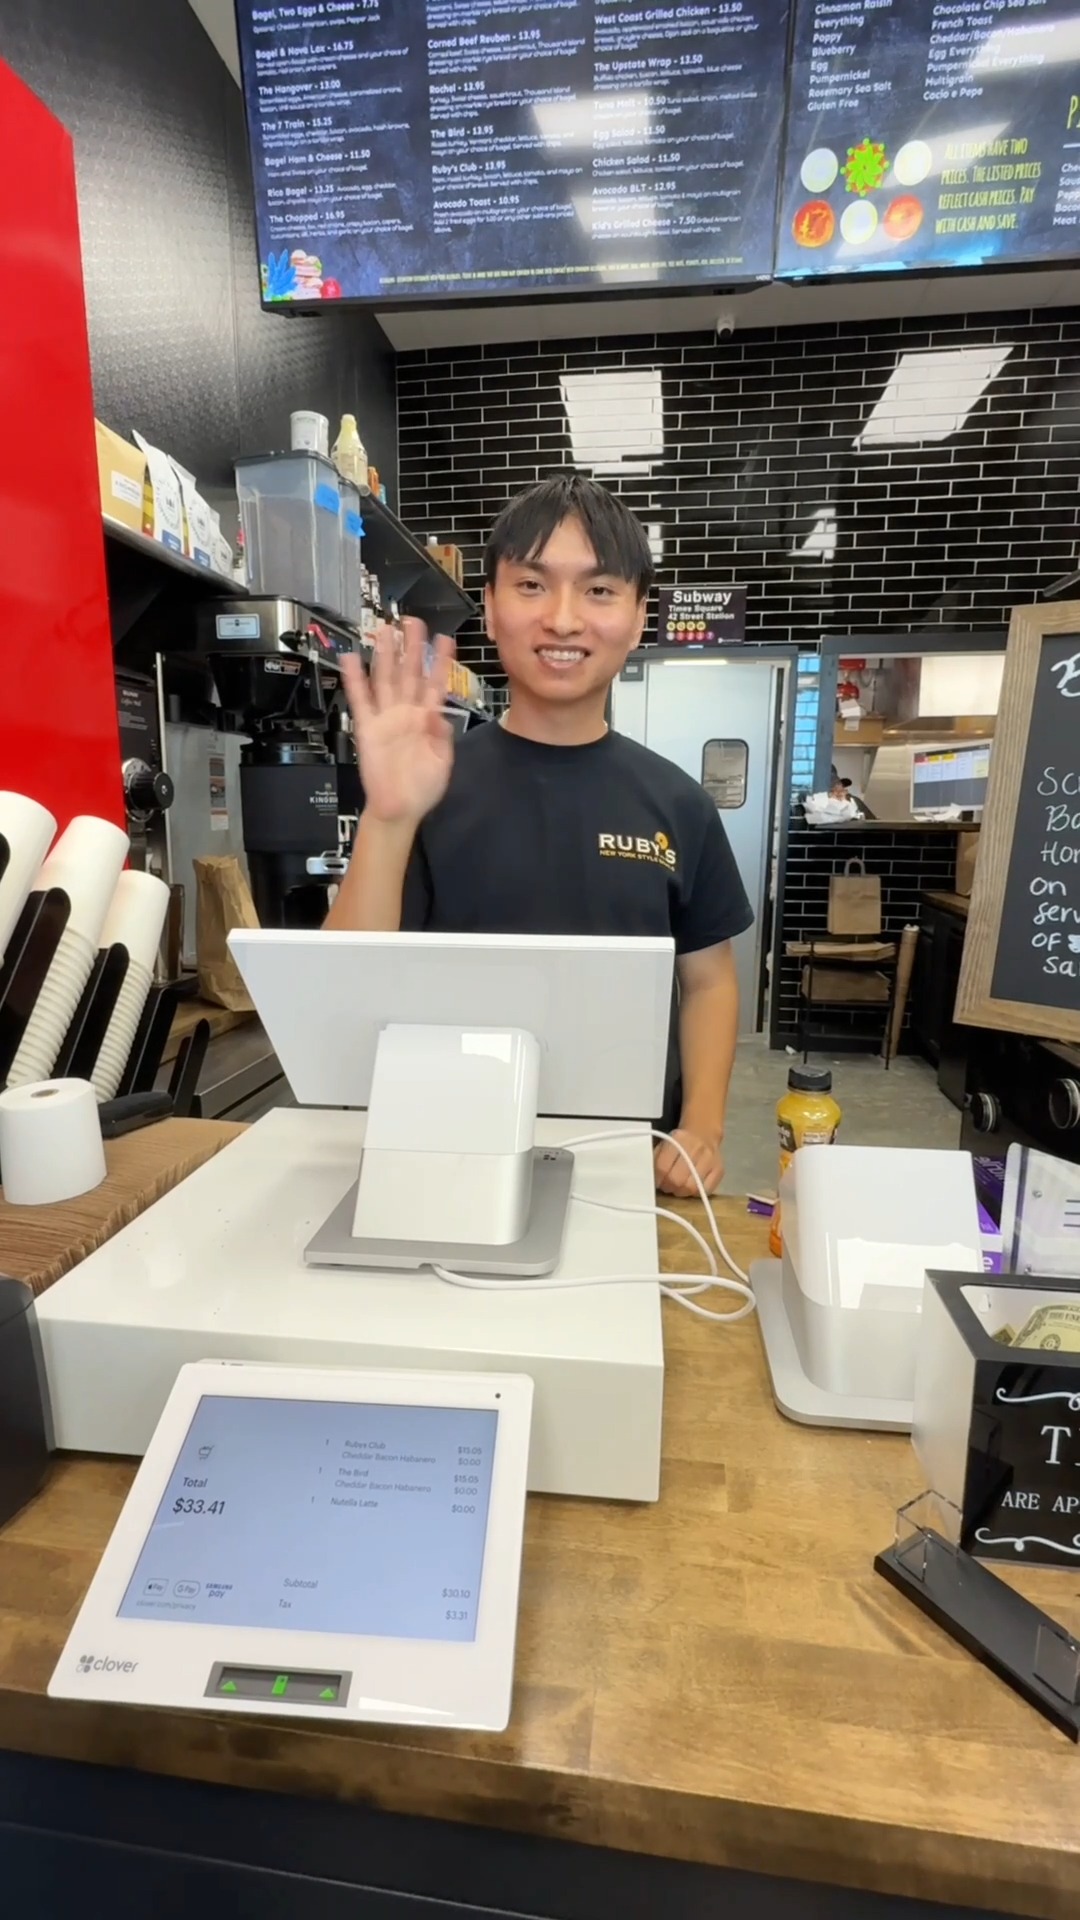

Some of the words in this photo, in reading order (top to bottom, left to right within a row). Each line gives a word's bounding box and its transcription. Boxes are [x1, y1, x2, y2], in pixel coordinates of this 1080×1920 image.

[279, 7, 295, 17] Two
[297, 6, 316, 18] Eggs
[326, 2, 355, 12] Cheese
[594, 14, 616, 24] West
[618, 12, 643, 23] Coast
[645, 8, 674, 20] Grilled
[676, 5, 710, 18] Chicken
[718, 3, 743, 13] 13.50
[815, 2, 861, 15] Cinnamon
[864, 0, 893, 10] Raisin
[933, 2, 980, 16] Chocolate
[983, 0, 1005, 11] Chip
[814, 15, 864, 29] Everything
[932, 18, 964, 30] French
[966, 15, 993, 26] Toast
[427, 37, 457, 49] Corned
[459, 35, 477, 47] Beef
[480, 33, 510, 45] Reuben
[812, 32, 842, 44] Poppy
[255, 48, 278, 60] Bagel
[288, 46, 309, 56] Nova
[812, 44, 856, 57] Blueberry
[928, 49, 947, 61] Egg
[949, 44, 1001, 58] Everything
[594, 62, 610, 71] The
[612, 59, 646, 72] Upstate
[648, 57, 671, 69] Wrap
[679, 54, 703, 65] 13.50
[810, 61, 828, 73] Egg
[926, 60, 990, 73] Pumpernickel
[809, 69, 870, 84] Pumpernickel
[925, 74, 974, 87] Multigrain
[258, 86, 273, 95] The
[275, 83, 312, 95] Hangover
[320, 80, 341, 89] 13.00
[429, 84, 456, 95] Rachel
[808, 86, 853, 98] Rosemary
[855, 84, 871, 94] Sea
[873, 80, 892, 92] Salt
[959, 87, 984, 99] Pepe
[807, 101, 837, 111] Gluten
[839, 99, 859, 108] Free
[261, 122, 276, 131] The
[285, 120, 305, 130] Train
[430, 129, 446, 139] The
[448, 127, 465, 138] Bird
[1010, 137, 1028, 155] TWO
[264, 157, 287, 168] Bagel
[288, 155, 306, 164] Ham
[316, 152, 342, 162] Cheese
[350, 150, 371, 159] 11.50
[592, 157, 625, 168] Chicken
[626, 155, 650, 165] Salad
[658, 153, 680, 163] 11.50
[432, 163, 458, 175] Ruby's
[459, 162, 477, 172] Club
[1014, 162, 1041, 180] PRICES
[286, 186, 307, 197] Bagel
[592, 186, 627, 196] Avocado
[630, 184, 647, 193] BLT
[654, 182, 676, 191] 12.95
[433, 199, 467, 209] Avocado
[469, 197, 491, 207] Toast
[498, 195, 520, 205] 10.95
[968, 190, 988, 207] CASH
[269, 214, 284, 224] The
[285, 212, 319, 224] Chopped
[642, 217, 671, 227] Cheese
[679, 215, 696, 226] 7.50
[957, 216, 977, 232] CASH
[977, 214, 996, 231] AND
[1053, 216, 1076, 226] Meat
[672, 590, 732, 606] Subway
[668, 604, 692, 613] Times
[694, 604, 723, 613] Square
[680, 612, 704, 620] Street
[706, 612, 735, 620] Station
[1037, 766, 1080, 796] Sc
[600, 849, 616, 857] NEW
[618, 850, 637, 859] YORK
[368, 1441, 386, 1450] Club
[342, 1452, 374, 1461] Cheddar
[375, 1453, 399, 1462] Bacon
[400, 1454, 436, 1464] Habanero
[458, 1457, 481, 1467] $0.00
[338, 1467, 352, 1477] The
[353, 1468, 369, 1478] Bird
[183, 1477, 208, 1489] Total
[335, 1480, 368, 1489] Cheddar
[369, 1481, 393, 1490] Bacon
[394, 1483, 432, 1493] Habanero
[454, 1486, 478, 1496] $0.00
[173, 1497, 226, 1515] $33.41
[331, 1497, 358, 1508] Nutella
[359, 1499, 379, 1509] Latte
[451, 1505, 476, 1514] $0.00
[1001, 1491, 1040, 1510] ARE
[1052, 1495, 1080, 1513] AP
[208, 1590, 226, 1599] pay
[284, 1577, 318, 1589] Subtotal
[442, 1588, 471, 1598] $30.10
[279, 1599, 292, 1609] Tax
[445, 1610, 468, 1620] $3.31
[93, 1657, 139, 1674] clover
